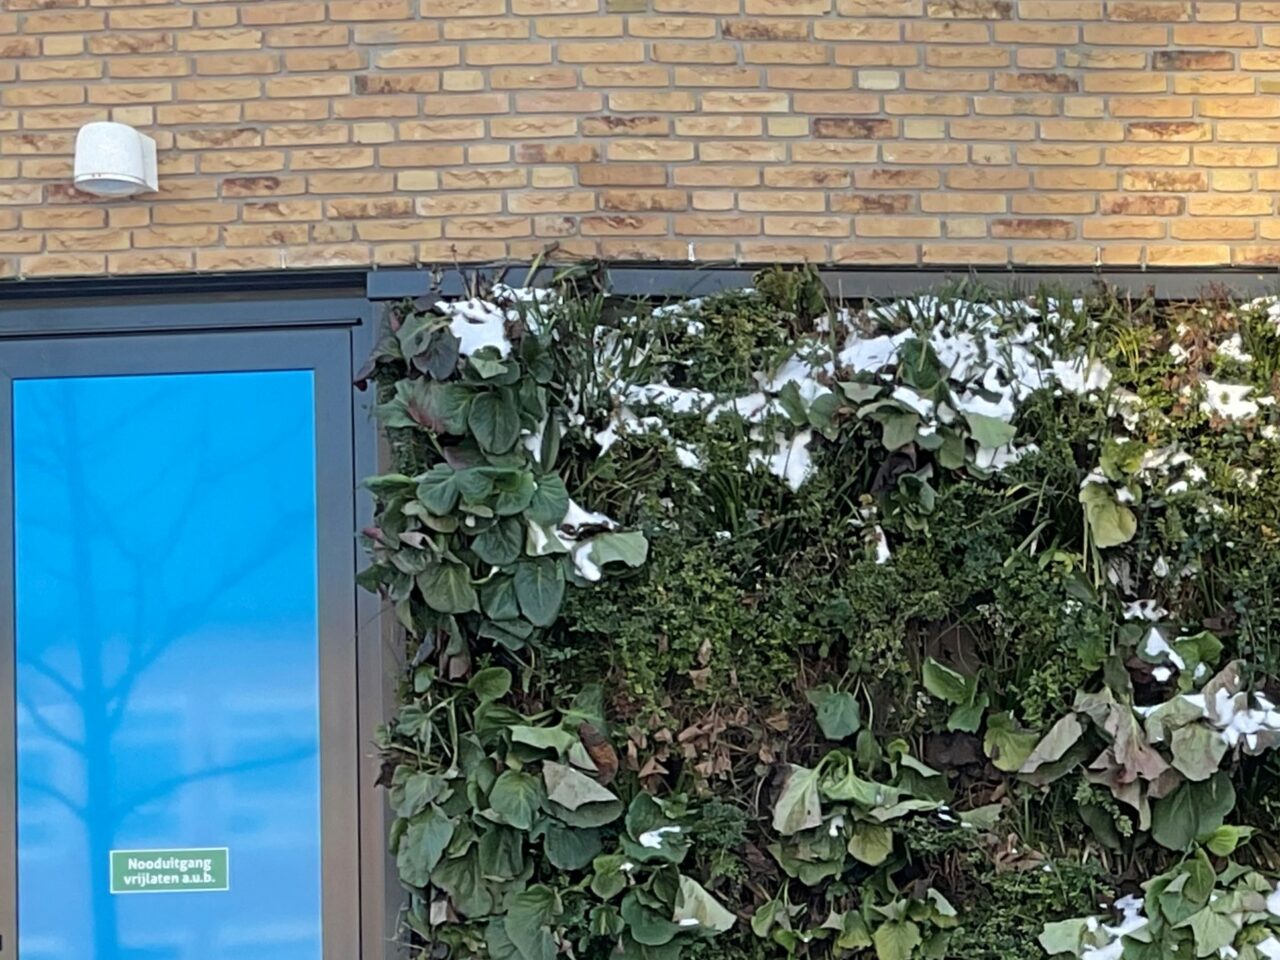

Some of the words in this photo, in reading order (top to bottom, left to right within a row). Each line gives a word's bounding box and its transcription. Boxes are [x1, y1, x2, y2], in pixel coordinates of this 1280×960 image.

[128, 857, 212, 872] Nooduitgang
[123, 872, 179, 887] vrijlaten
[182, 872, 216, 884] a.u.b.
